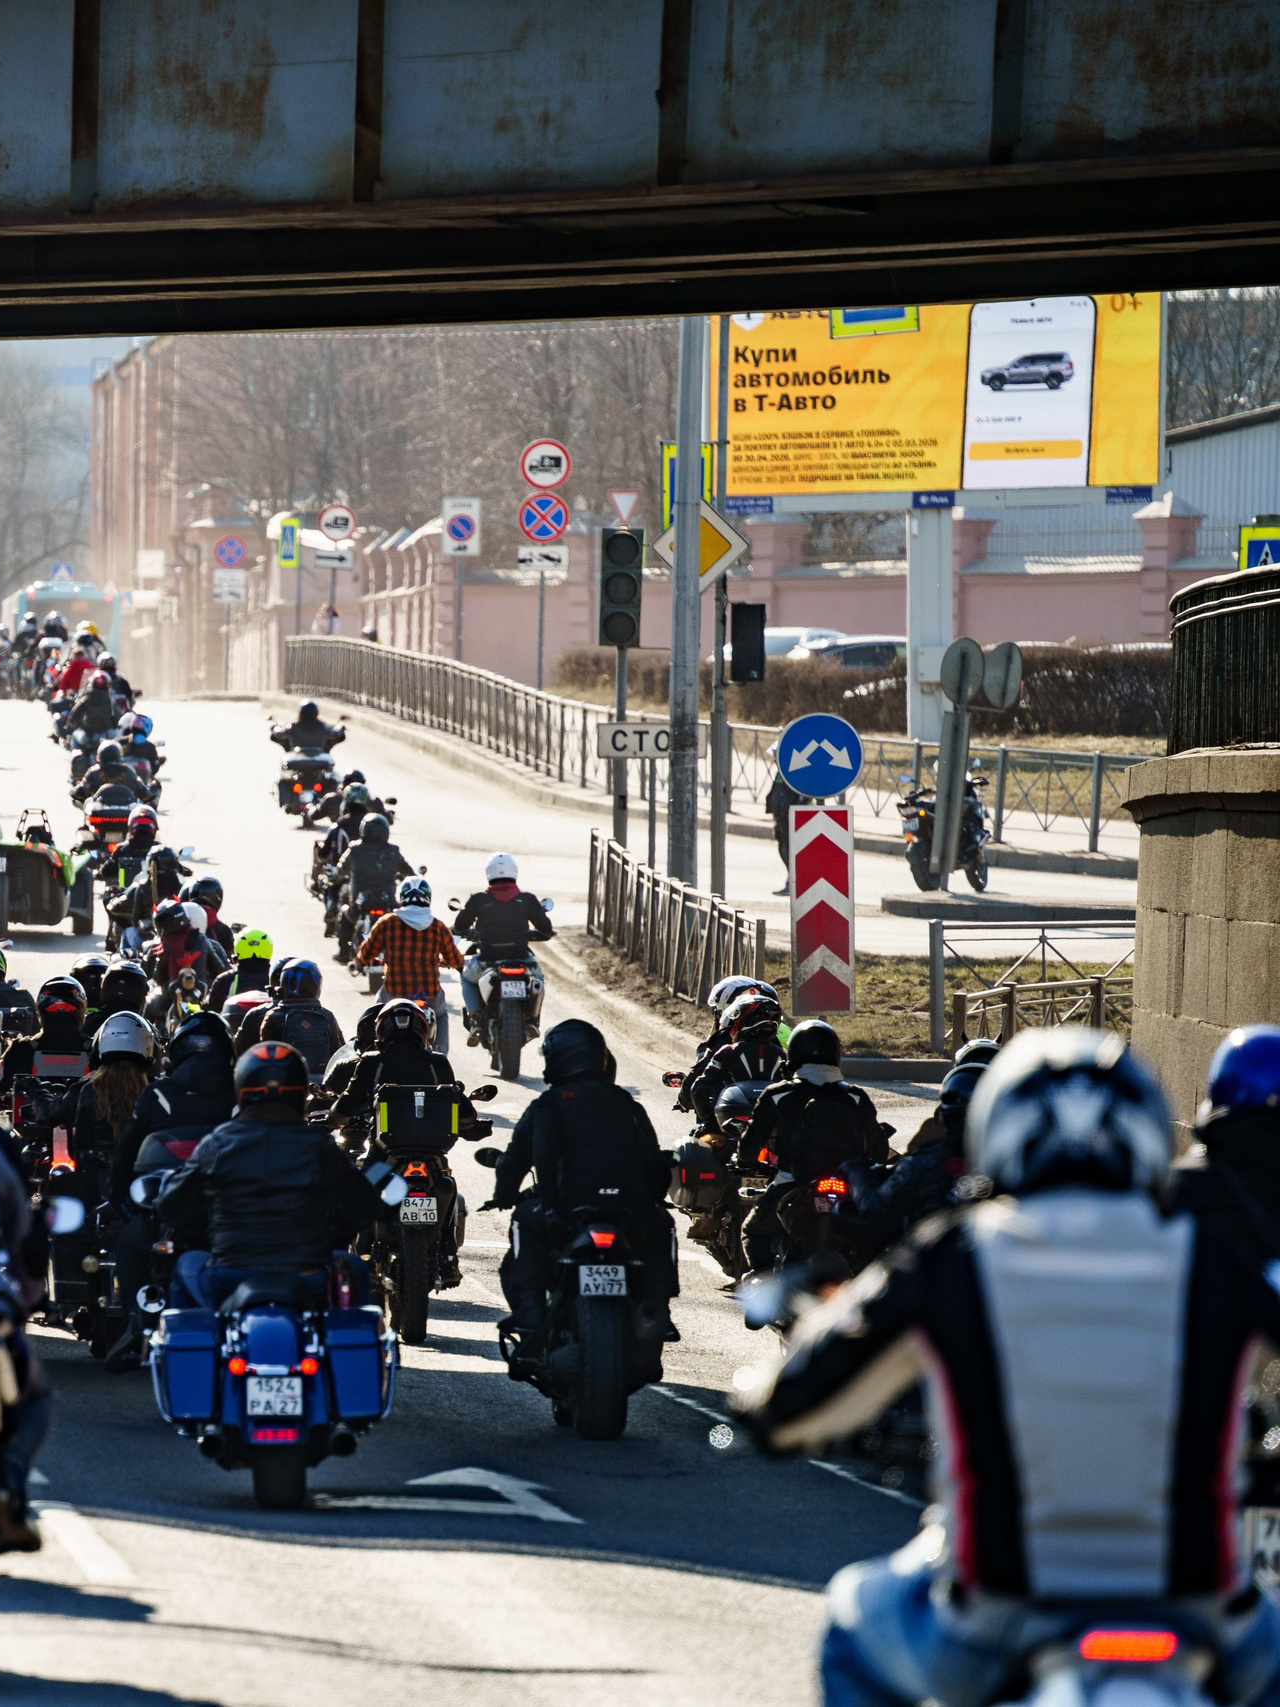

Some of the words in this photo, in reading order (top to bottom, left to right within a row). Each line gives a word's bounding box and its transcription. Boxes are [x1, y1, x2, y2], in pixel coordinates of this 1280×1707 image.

[734, 346, 797, 368] Купи
[733, 365, 890, 388] автомобиль
[734, 398, 747, 412] в
[754, 393, 837, 412] Т-Авто
[611, 729, 670, 752] СТО
[746, 1178, 768, 1188] 241
[403, 1198, 432, 1207] 8477
[402, 1212, 418, 1221] АВ
[422, 1212, 435, 1220] 10
[586, 1266, 619, 1277] 3449
[606, 1282, 623, 1293] 77
[255, 1379, 295, 1393] 1524
[279, 1400, 298, 1414] 27
